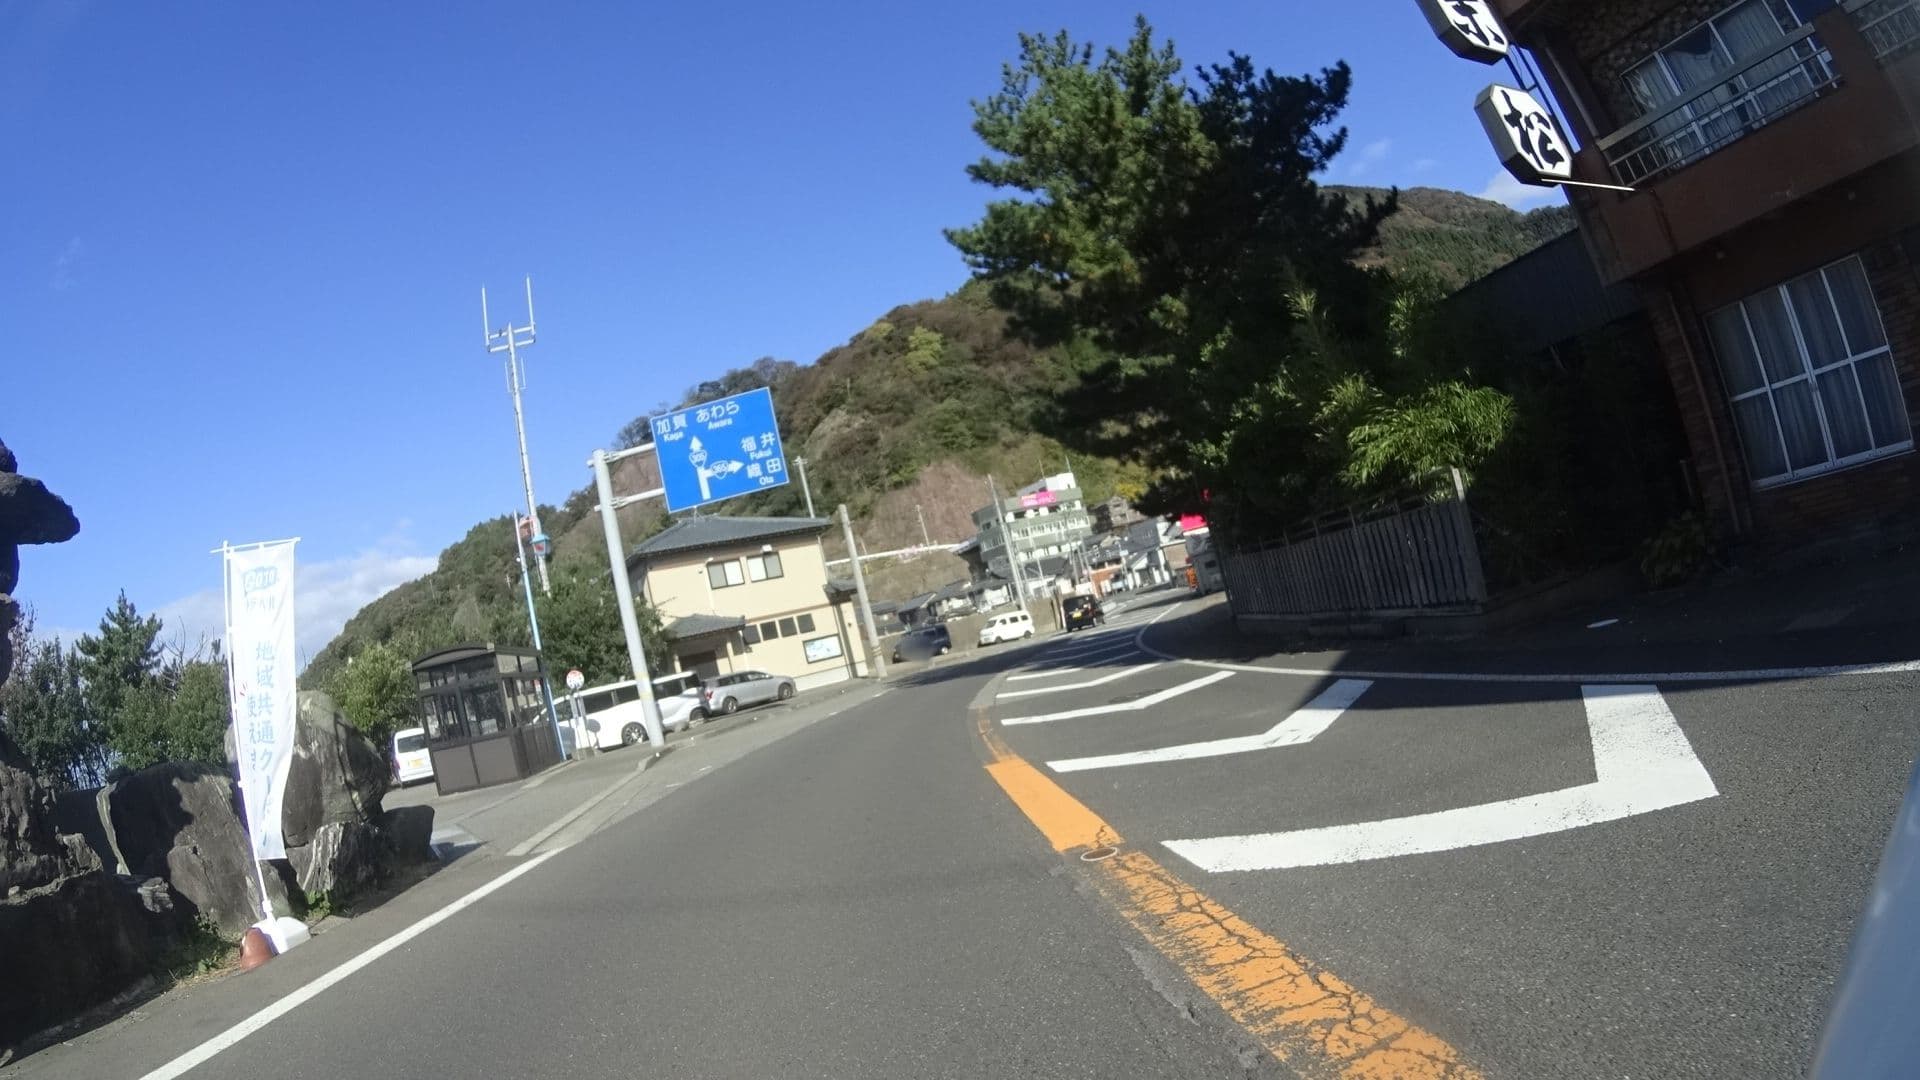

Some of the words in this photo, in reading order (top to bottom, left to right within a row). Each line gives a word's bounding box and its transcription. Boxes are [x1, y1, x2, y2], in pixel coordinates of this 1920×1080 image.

[656, 413, 688, 435] 加賀
[695, 400, 740, 423] あわら
[663, 431, 684, 442] Kaga
[707, 418, 733, 430] Awara
[741, 431, 776, 453] 福井
[749, 448, 773, 460] Fukui
[759, 476, 775, 485] Ota
